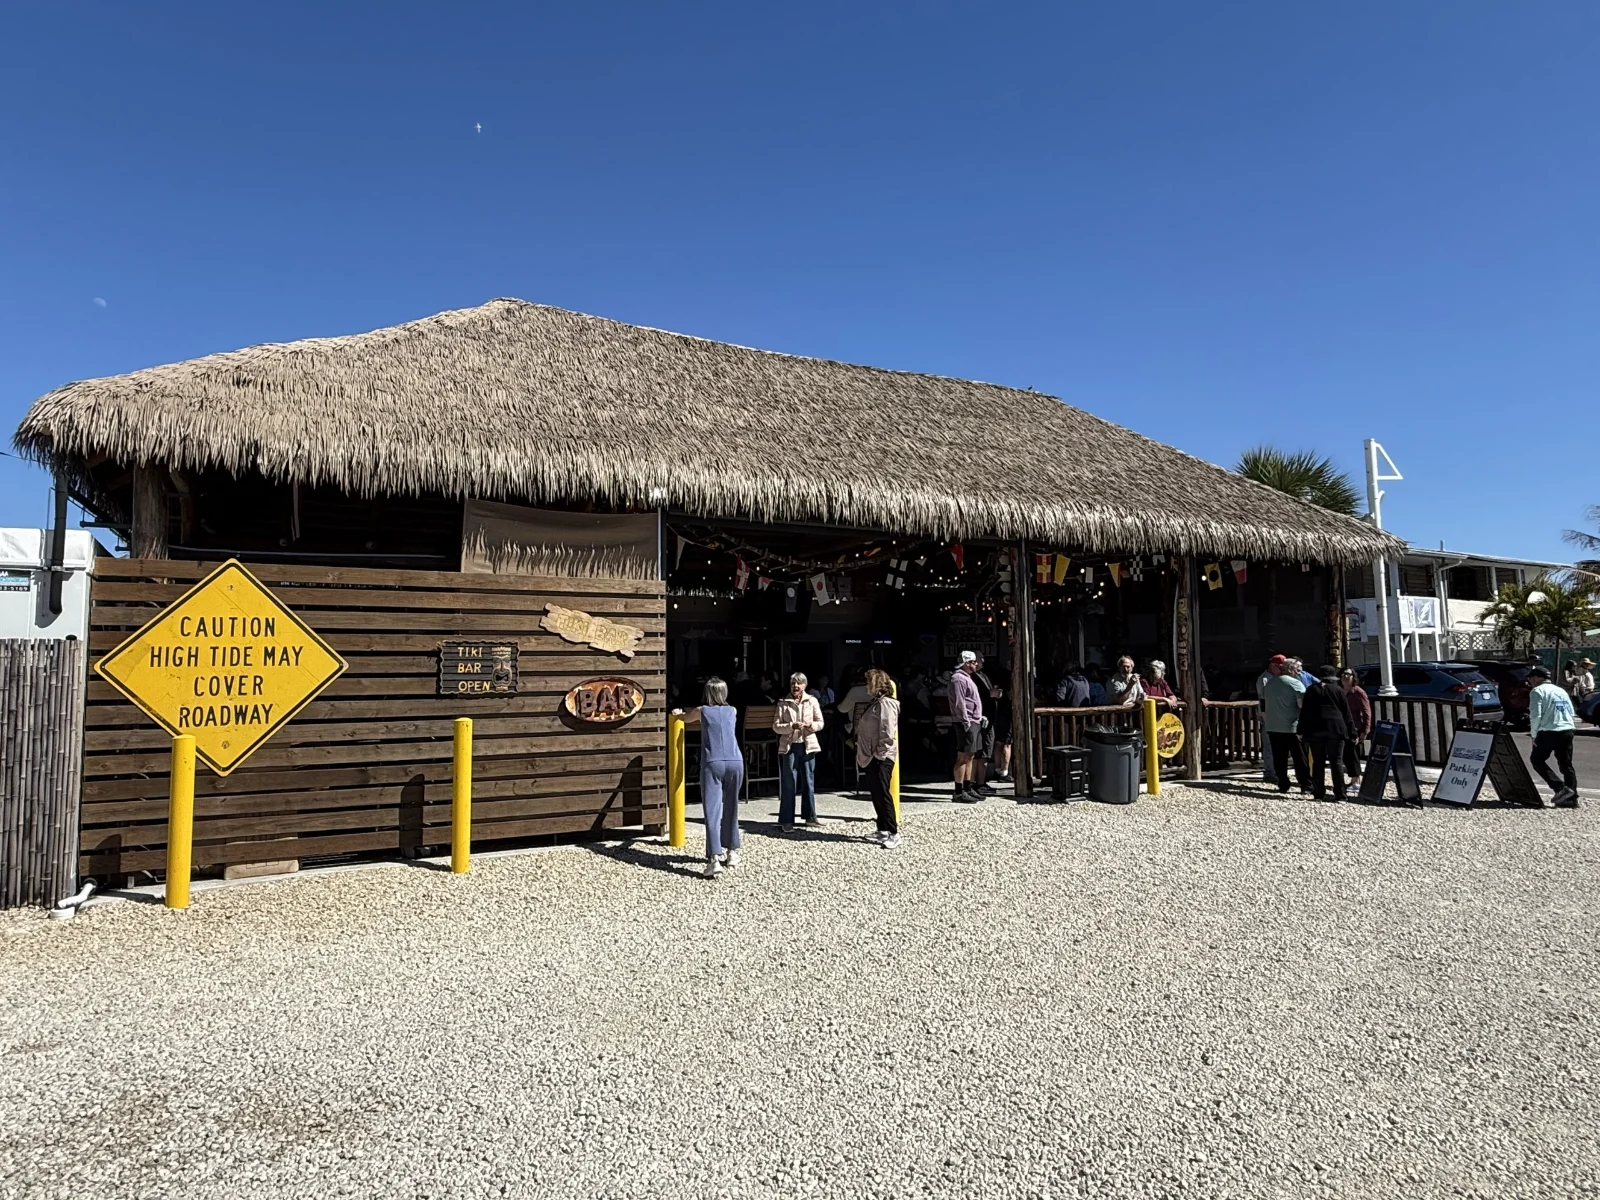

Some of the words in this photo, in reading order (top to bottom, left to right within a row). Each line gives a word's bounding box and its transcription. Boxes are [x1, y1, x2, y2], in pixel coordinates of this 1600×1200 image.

[180, 616, 276, 638] CAUTION
[557, 613, 589, 638] TIKI
[595, 623, 629, 647] BAR
[150, 646, 199, 667] HIGH
[210, 646, 253, 667] TIDE
[263, 646, 304, 667] MAY
[457, 662, 482, 673] BAR
[193, 675, 264, 697] COVER
[458, 681, 491, 691] OPEN
[577, 684, 637, 716] BAR
[179, 703, 274, 728] ROADWAY
[1449, 762, 1480, 777] Parking
[1450, 777, 1468, 788] Only
